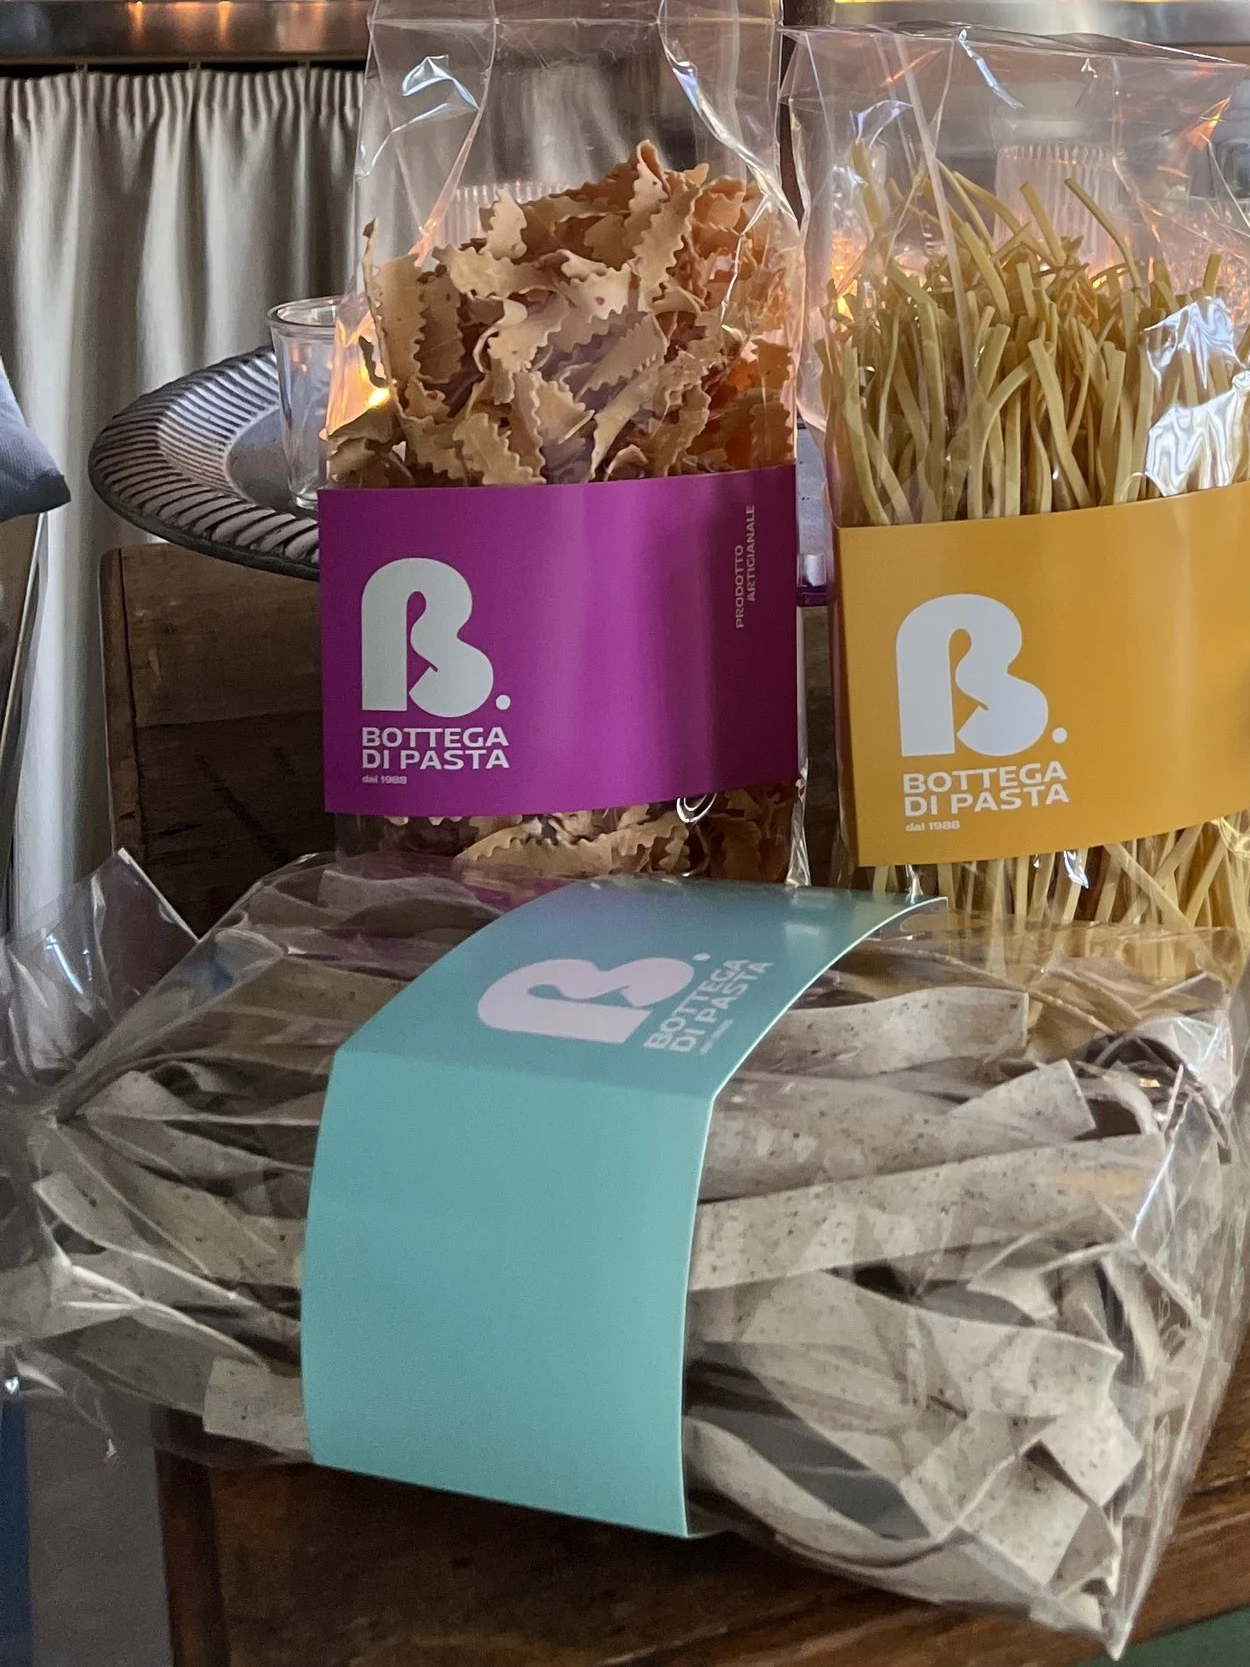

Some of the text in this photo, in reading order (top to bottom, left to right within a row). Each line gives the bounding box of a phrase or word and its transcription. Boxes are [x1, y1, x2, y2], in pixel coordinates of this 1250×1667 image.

[746, 504, 756, 602] ARTIGIANALE
[734, 544, 744, 629] PRODOTTO
[361, 726, 510, 748] BOTTEGA
[361, 749, 511, 771] DI PASTA
[902, 760, 1068, 795] BOTTEGA
[904, 783, 1071, 818] DI PASTA
[904, 819, 961, 832] dal 1988
[643, 959, 751, 1049] BOTTEGA
[668, 1028, 706, 1052] DI
[695, 962, 774, 1024] PASTA
